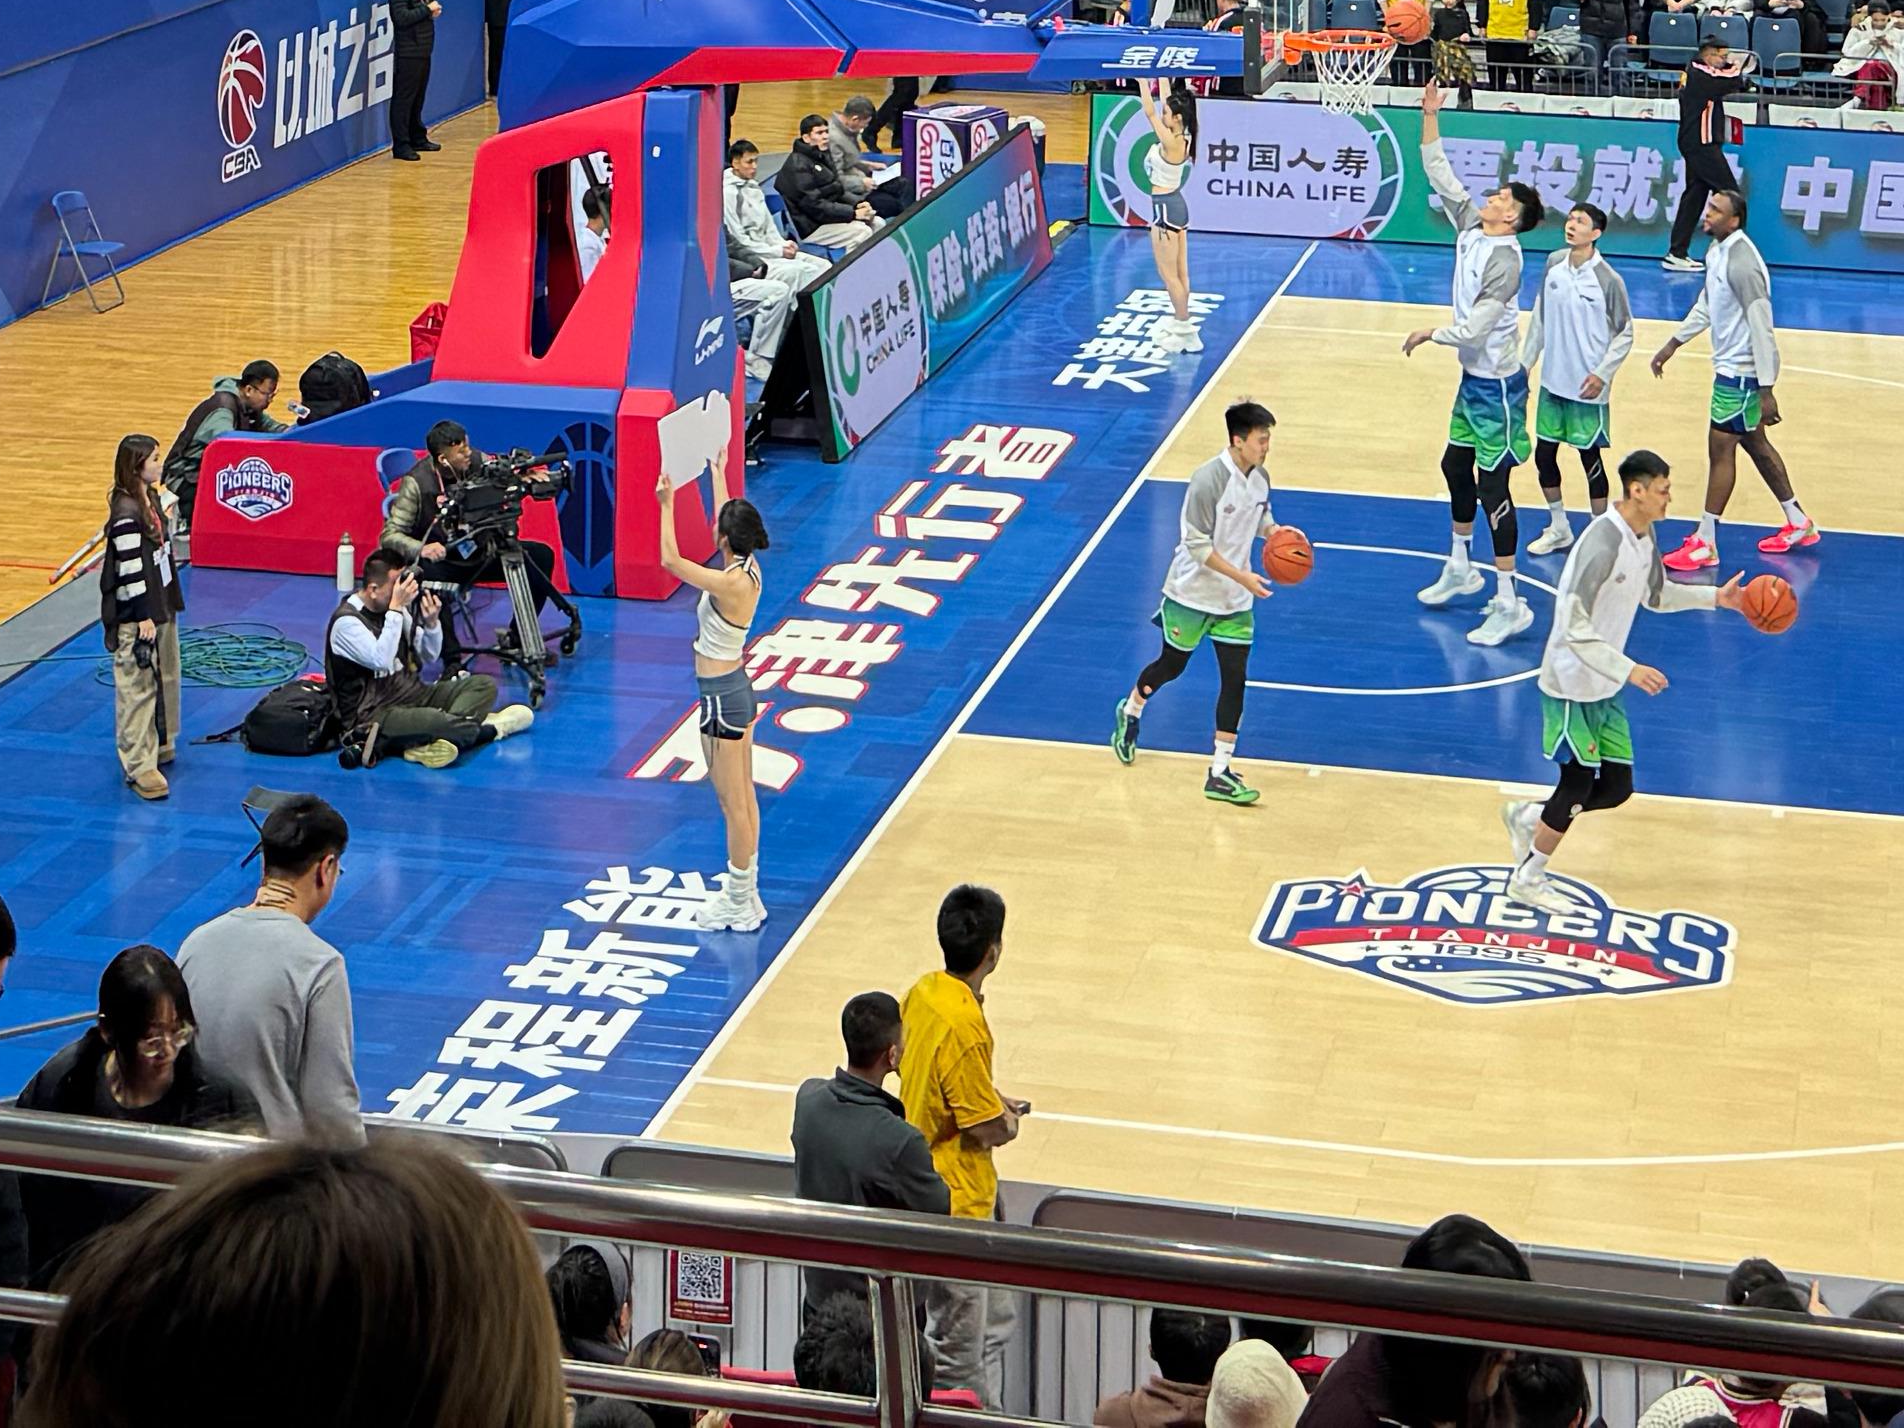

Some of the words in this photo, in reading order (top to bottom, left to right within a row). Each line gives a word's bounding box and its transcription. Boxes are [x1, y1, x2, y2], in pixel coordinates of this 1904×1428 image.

[272, 2, 395, 148] 以城之名
[1119, 45, 1199, 69] 金陵
[219, 143, 263, 183] CBA
[1207, 139, 1369, 181] 中国人寿
[1207, 179, 1293, 202] CHINA
[1306, 182, 1367, 204] LIFE
[860, 280, 910, 342] 中国人寿
[866, 342, 895, 375] CHINA
[896, 318, 917, 350] LIFE
[220, 472, 289, 503] PIONEERS
[1269, 883, 1717, 980] PIONEERS
[1367, 928, 1618, 965] TIANJIN
[1431, 943, 1547, 964] 1895
